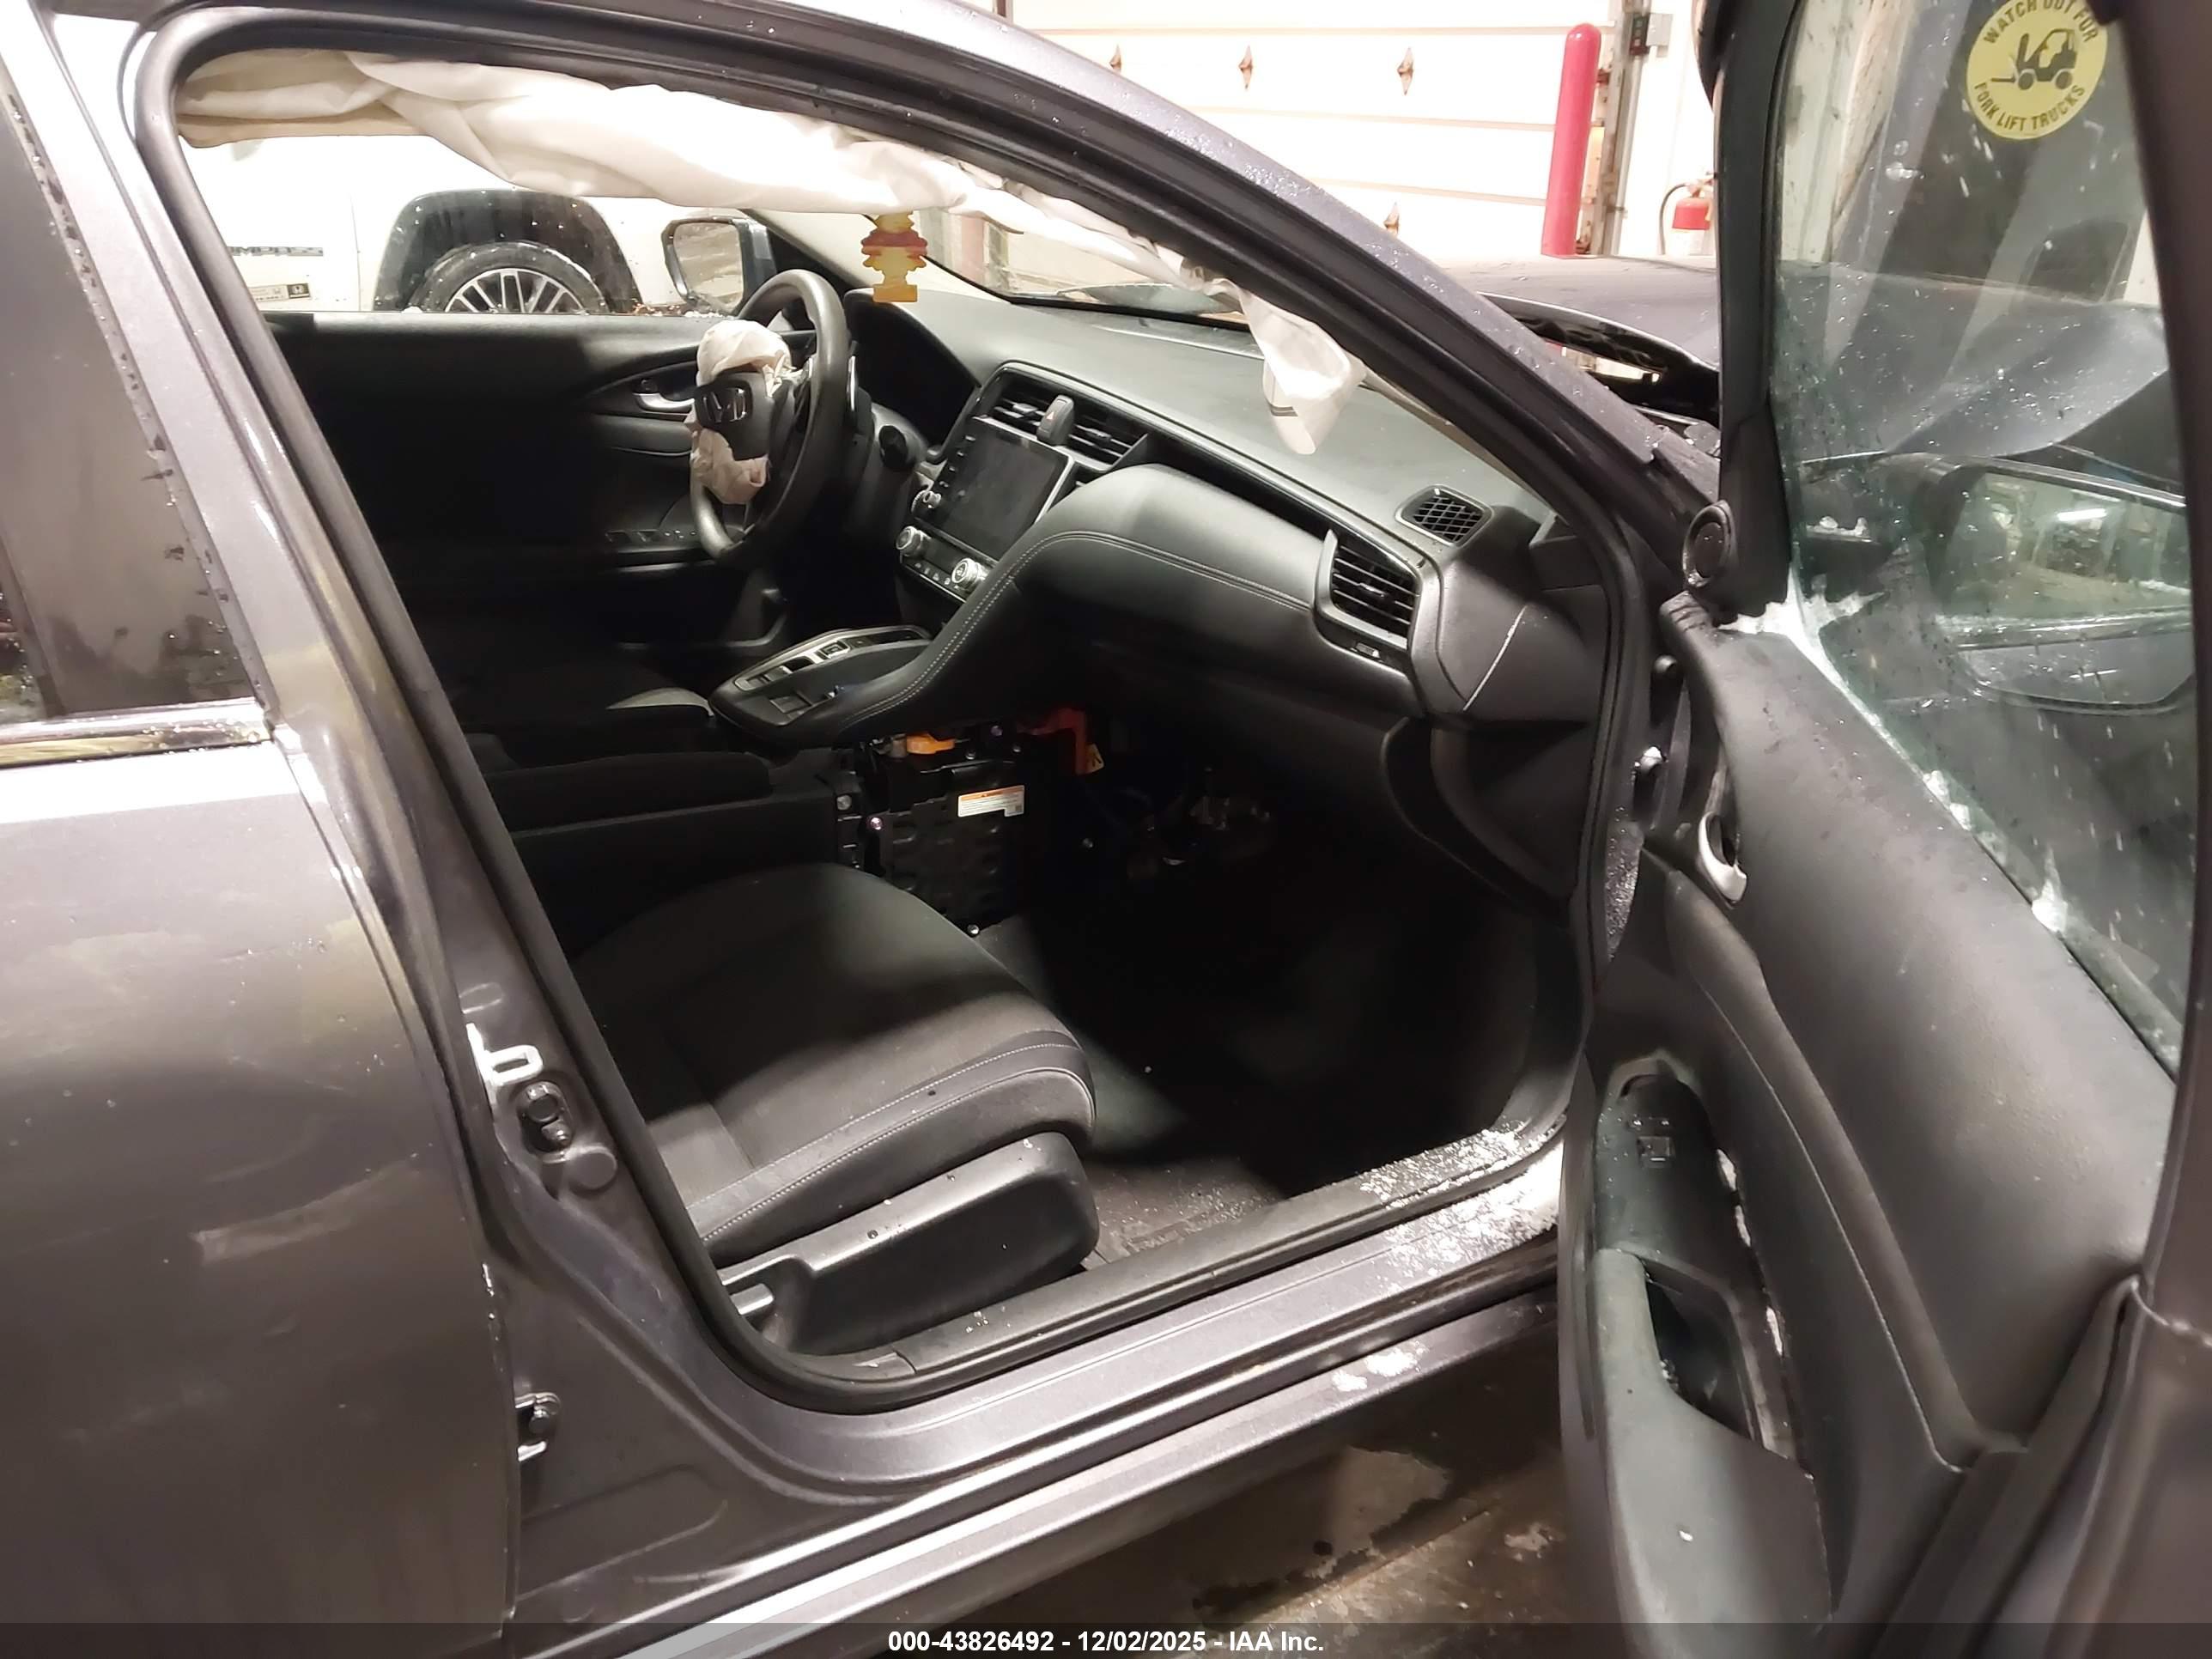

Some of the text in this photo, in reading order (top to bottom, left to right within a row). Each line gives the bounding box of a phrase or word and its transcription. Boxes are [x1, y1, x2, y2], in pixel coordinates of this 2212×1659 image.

[1984, 0, 2037, 43] WATCH
[2073, 7, 2099, 42] FOR
[1974, 82, 2085, 131] FORK LIFT TRUCKS
